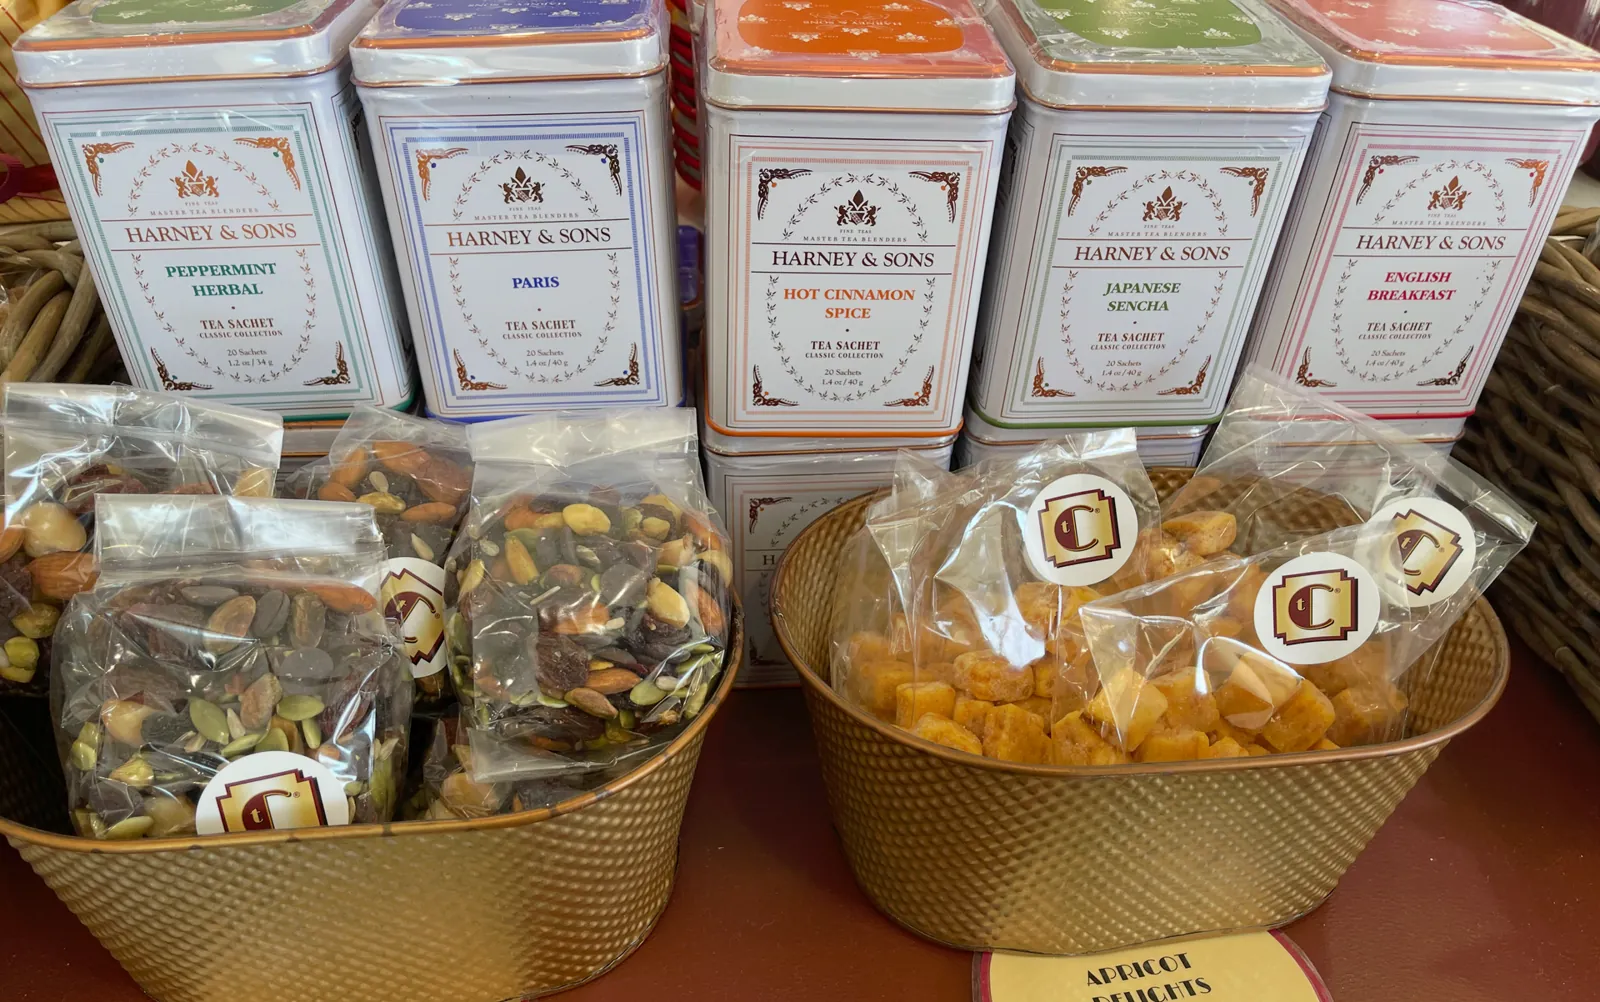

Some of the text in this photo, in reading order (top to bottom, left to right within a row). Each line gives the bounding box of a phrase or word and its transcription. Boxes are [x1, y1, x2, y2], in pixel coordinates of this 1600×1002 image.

[125, 222, 297, 243] HARNEY & SONS
[447, 227, 611, 247] HARNEY & SONS
[1356, 235, 1506, 250] HARNEY & SONS
[772, 250, 934, 268] HARNEY & SONS
[1074, 246, 1231, 261] HARNEY & SONS
[164, 262, 277, 278] PEPPERMINT
[512, 276, 560, 289] PARIS
[1384, 272, 1452, 283] ENGLISH
[192, 283, 263, 296] HERBAL
[783, 288, 916, 301] HOT CINNAMON
[1102, 282, 1181, 296] JAPANESE
[1366, 290, 1456, 301] BREAKFAST
[1107, 300, 1169, 312] SENCHA
[825, 308, 871, 319] SPICE
[200, 318, 274, 330] TEA SACHET
[505, 320, 576, 331] TEA SACHET
[1367, 322, 1432, 331] TEA SACHET
[199, 330, 283, 339] CLASSIC COLLECTION
[1098, 332, 1165, 342] TEA SACHET
[811, 341, 880, 350] TEA SACHET
[238, 348, 267, 356] Sachets
[228, 359, 240, 367] 1.2
[256, 358, 266, 366] 34
[836, 368, 862, 376] Sachets
[1086, 952, 1192, 986] APRICOT
